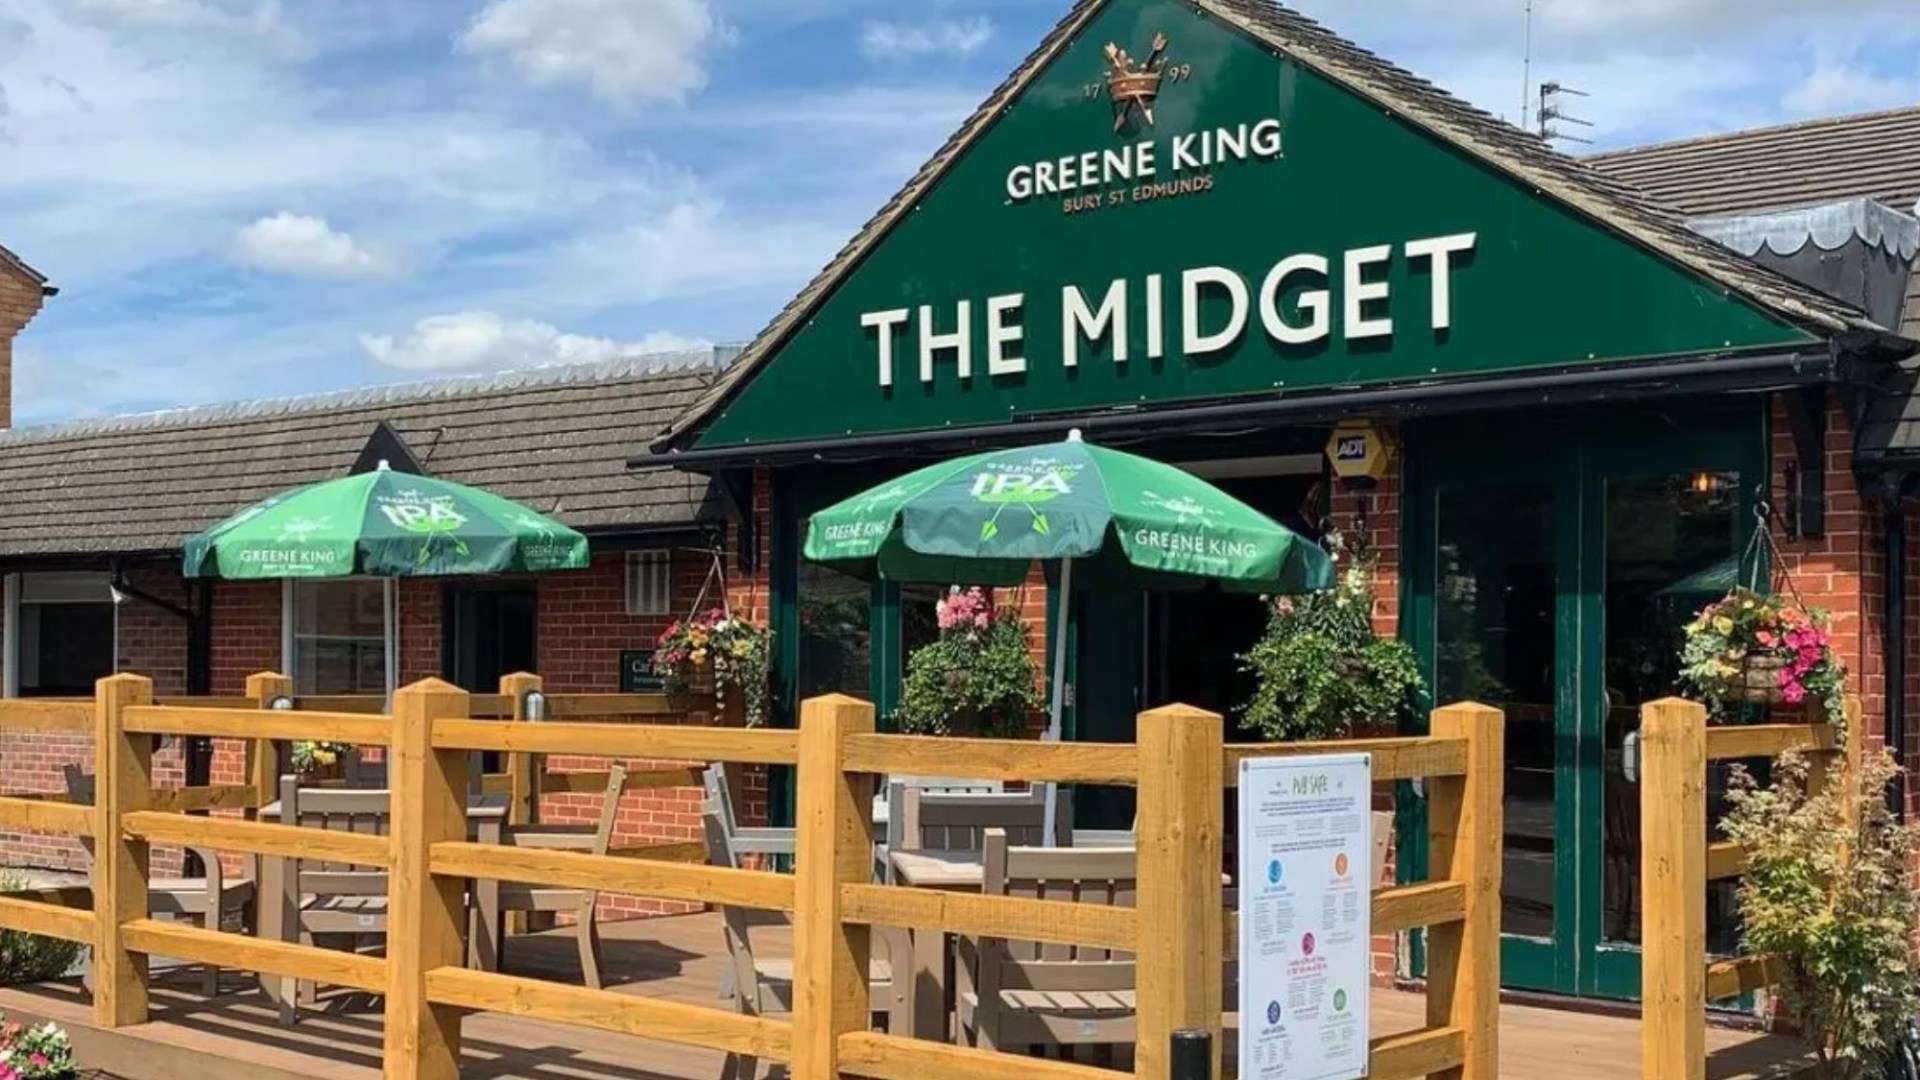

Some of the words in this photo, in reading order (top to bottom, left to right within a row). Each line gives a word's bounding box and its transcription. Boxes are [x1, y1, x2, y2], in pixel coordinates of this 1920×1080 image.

[1006, 141, 1156, 199] GREENE
[1172, 119, 1281, 170] KING
[1063, 194, 1102, 213] BURY
[1109, 189, 1126, 205] ST
[1132, 175, 1214, 201] EDMUNDS
[861, 293, 1027, 387] THE
[1063, 232, 1477, 367] MIDGET
[1337, 439, 1366, 457] ADT
[971, 471, 1072, 496] IPA
[381, 503, 468, 530] IPA
[825, 522, 863, 540] GREENE
[1135, 529, 1204, 552] GREENE
[1209, 539, 1256, 558] KING
[240, 550, 298, 563] GREENE
[300, 550, 335, 563] KING
